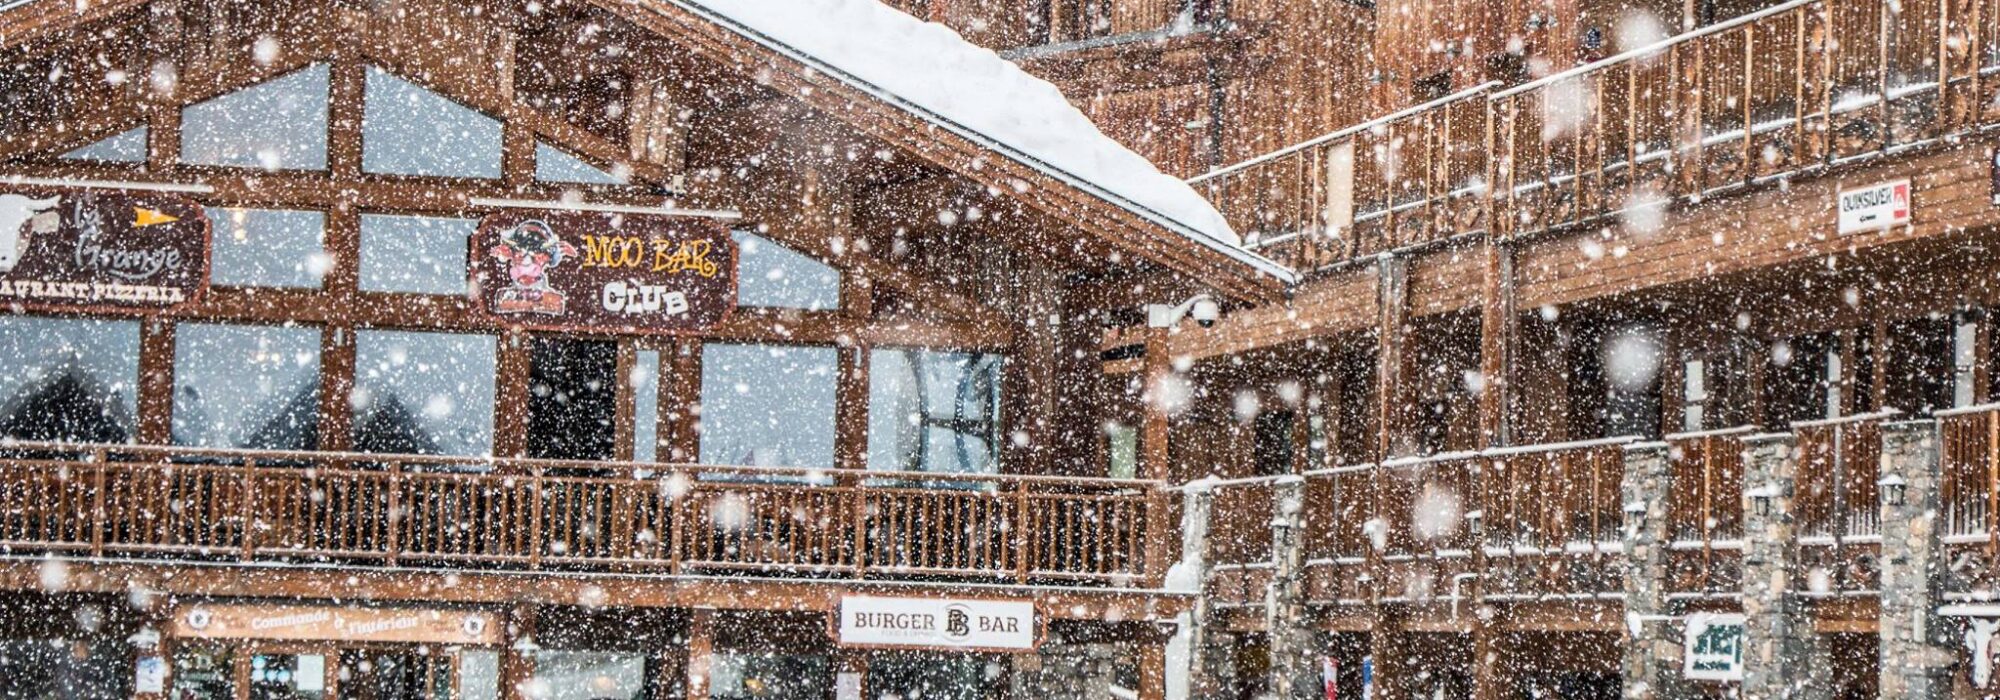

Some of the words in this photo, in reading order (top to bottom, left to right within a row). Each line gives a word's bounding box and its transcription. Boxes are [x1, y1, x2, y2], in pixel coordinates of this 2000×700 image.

[1843, 187, 1892, 212] QUIKSILVER
[75, 226, 182, 280] Grange
[582, 235, 643, 268] MOO
[652, 239, 717, 277] BAR
[93, 284, 184, 302] PIZZERIA
[602, 281, 689, 316] CLUB
[855, 612, 935, 631] BURGER
[979, 616, 1019, 633] BAR
